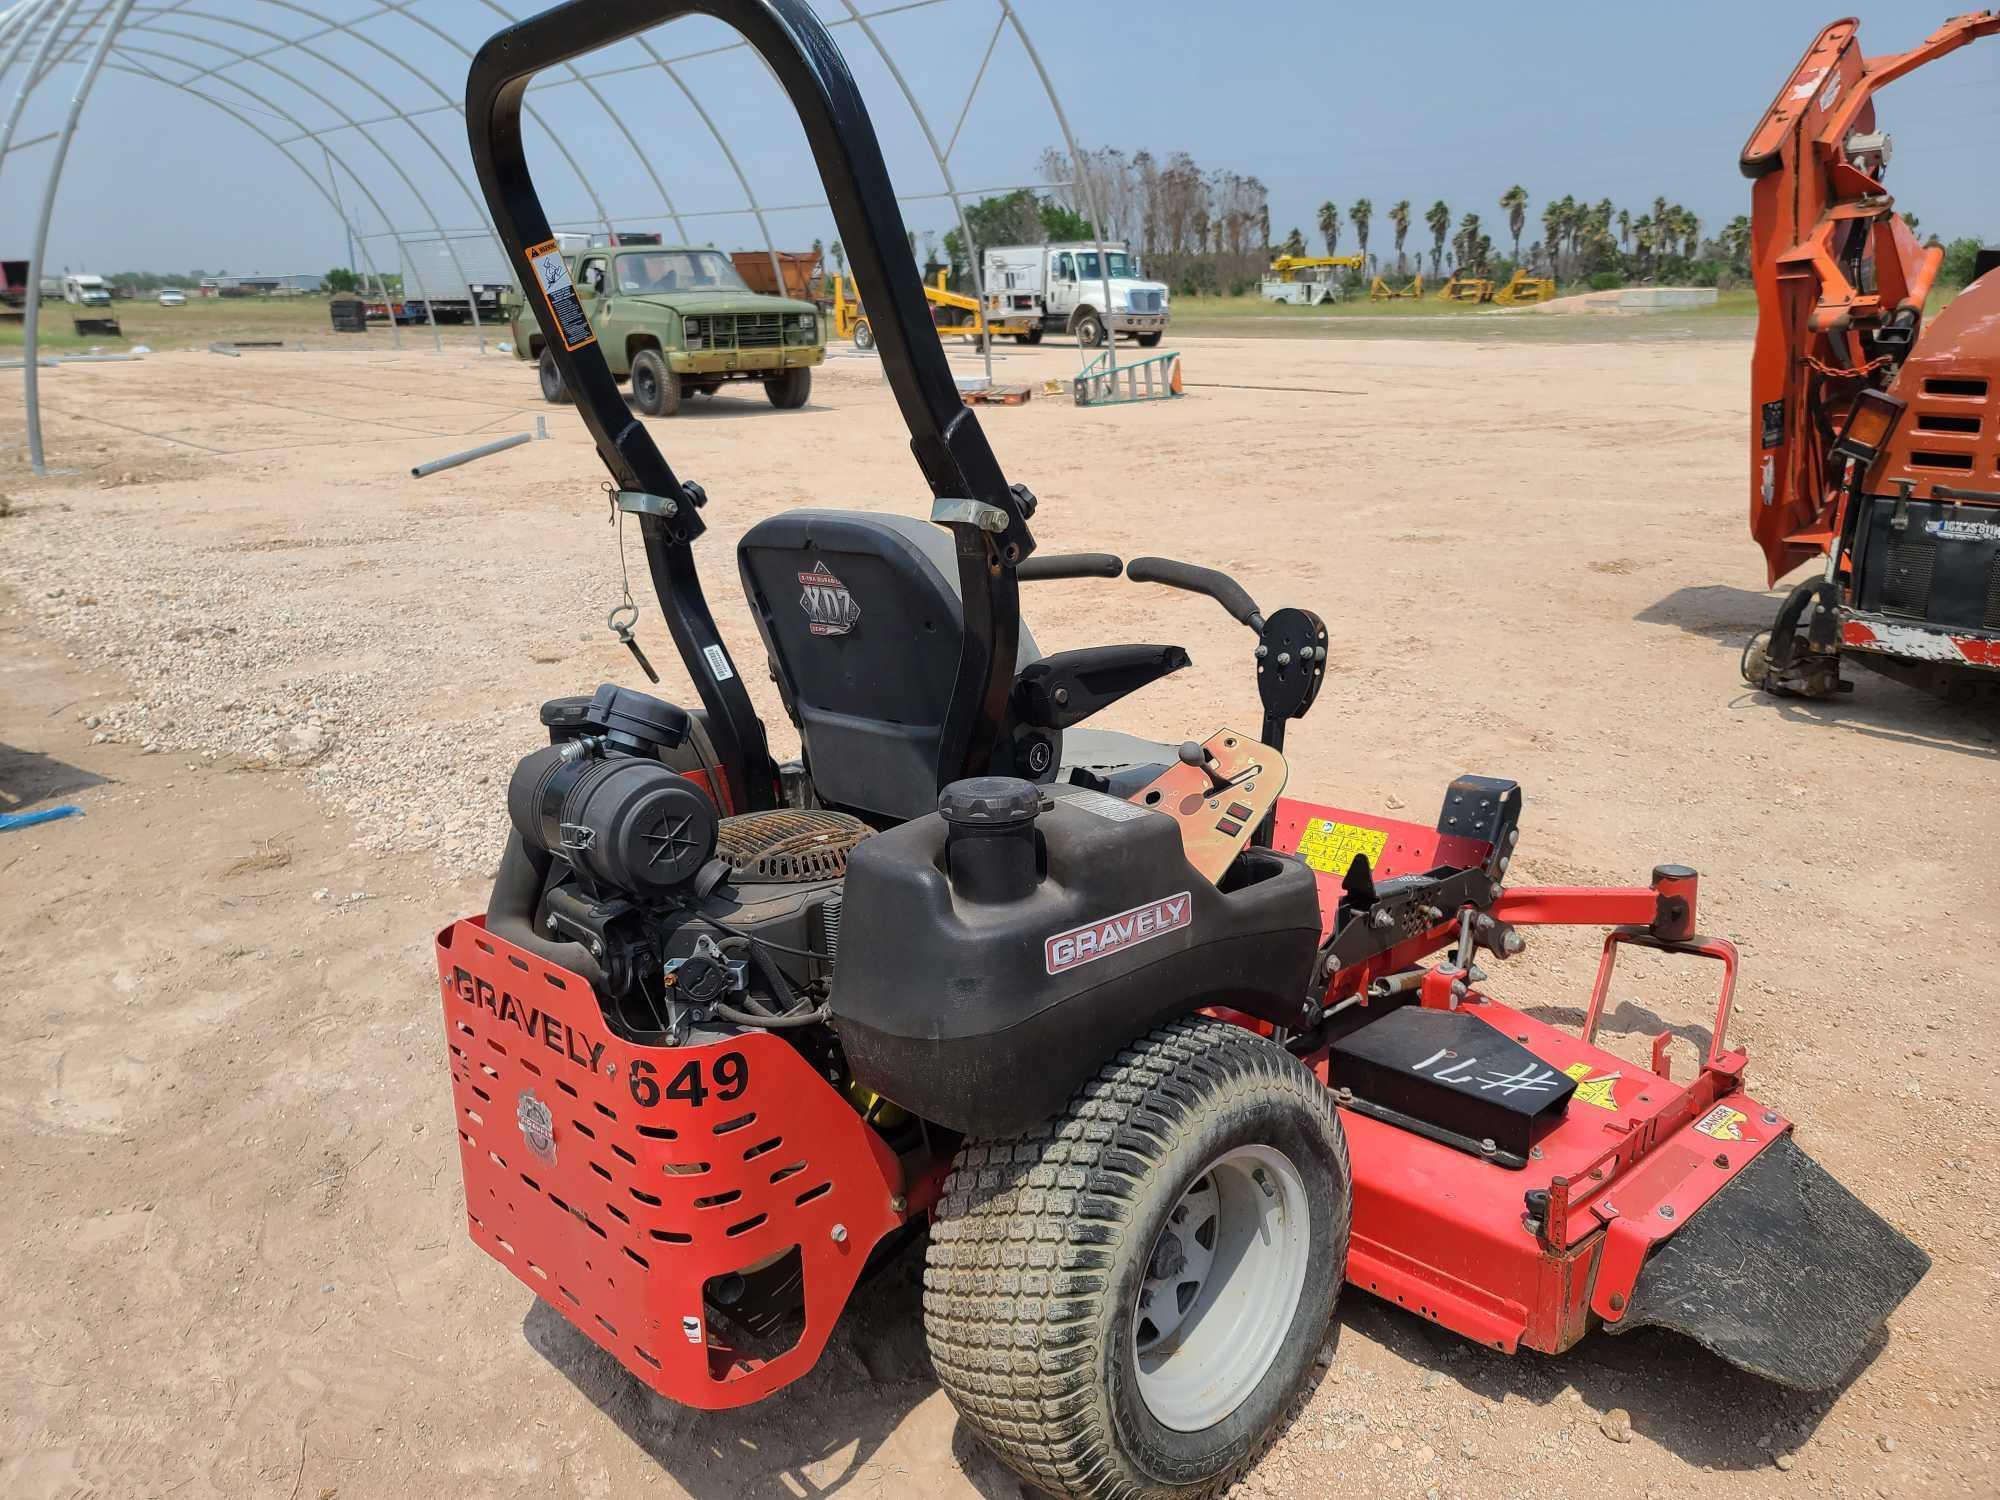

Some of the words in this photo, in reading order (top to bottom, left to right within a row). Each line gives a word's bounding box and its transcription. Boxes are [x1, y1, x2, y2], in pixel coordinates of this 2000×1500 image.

[1053, 898, 1186, 966] GRAVELY
[453, 965, 605, 1073] GRAVELY
[629, 1051, 748, 1107] 649
[1700, 1108, 1730, 1131] DANGER
